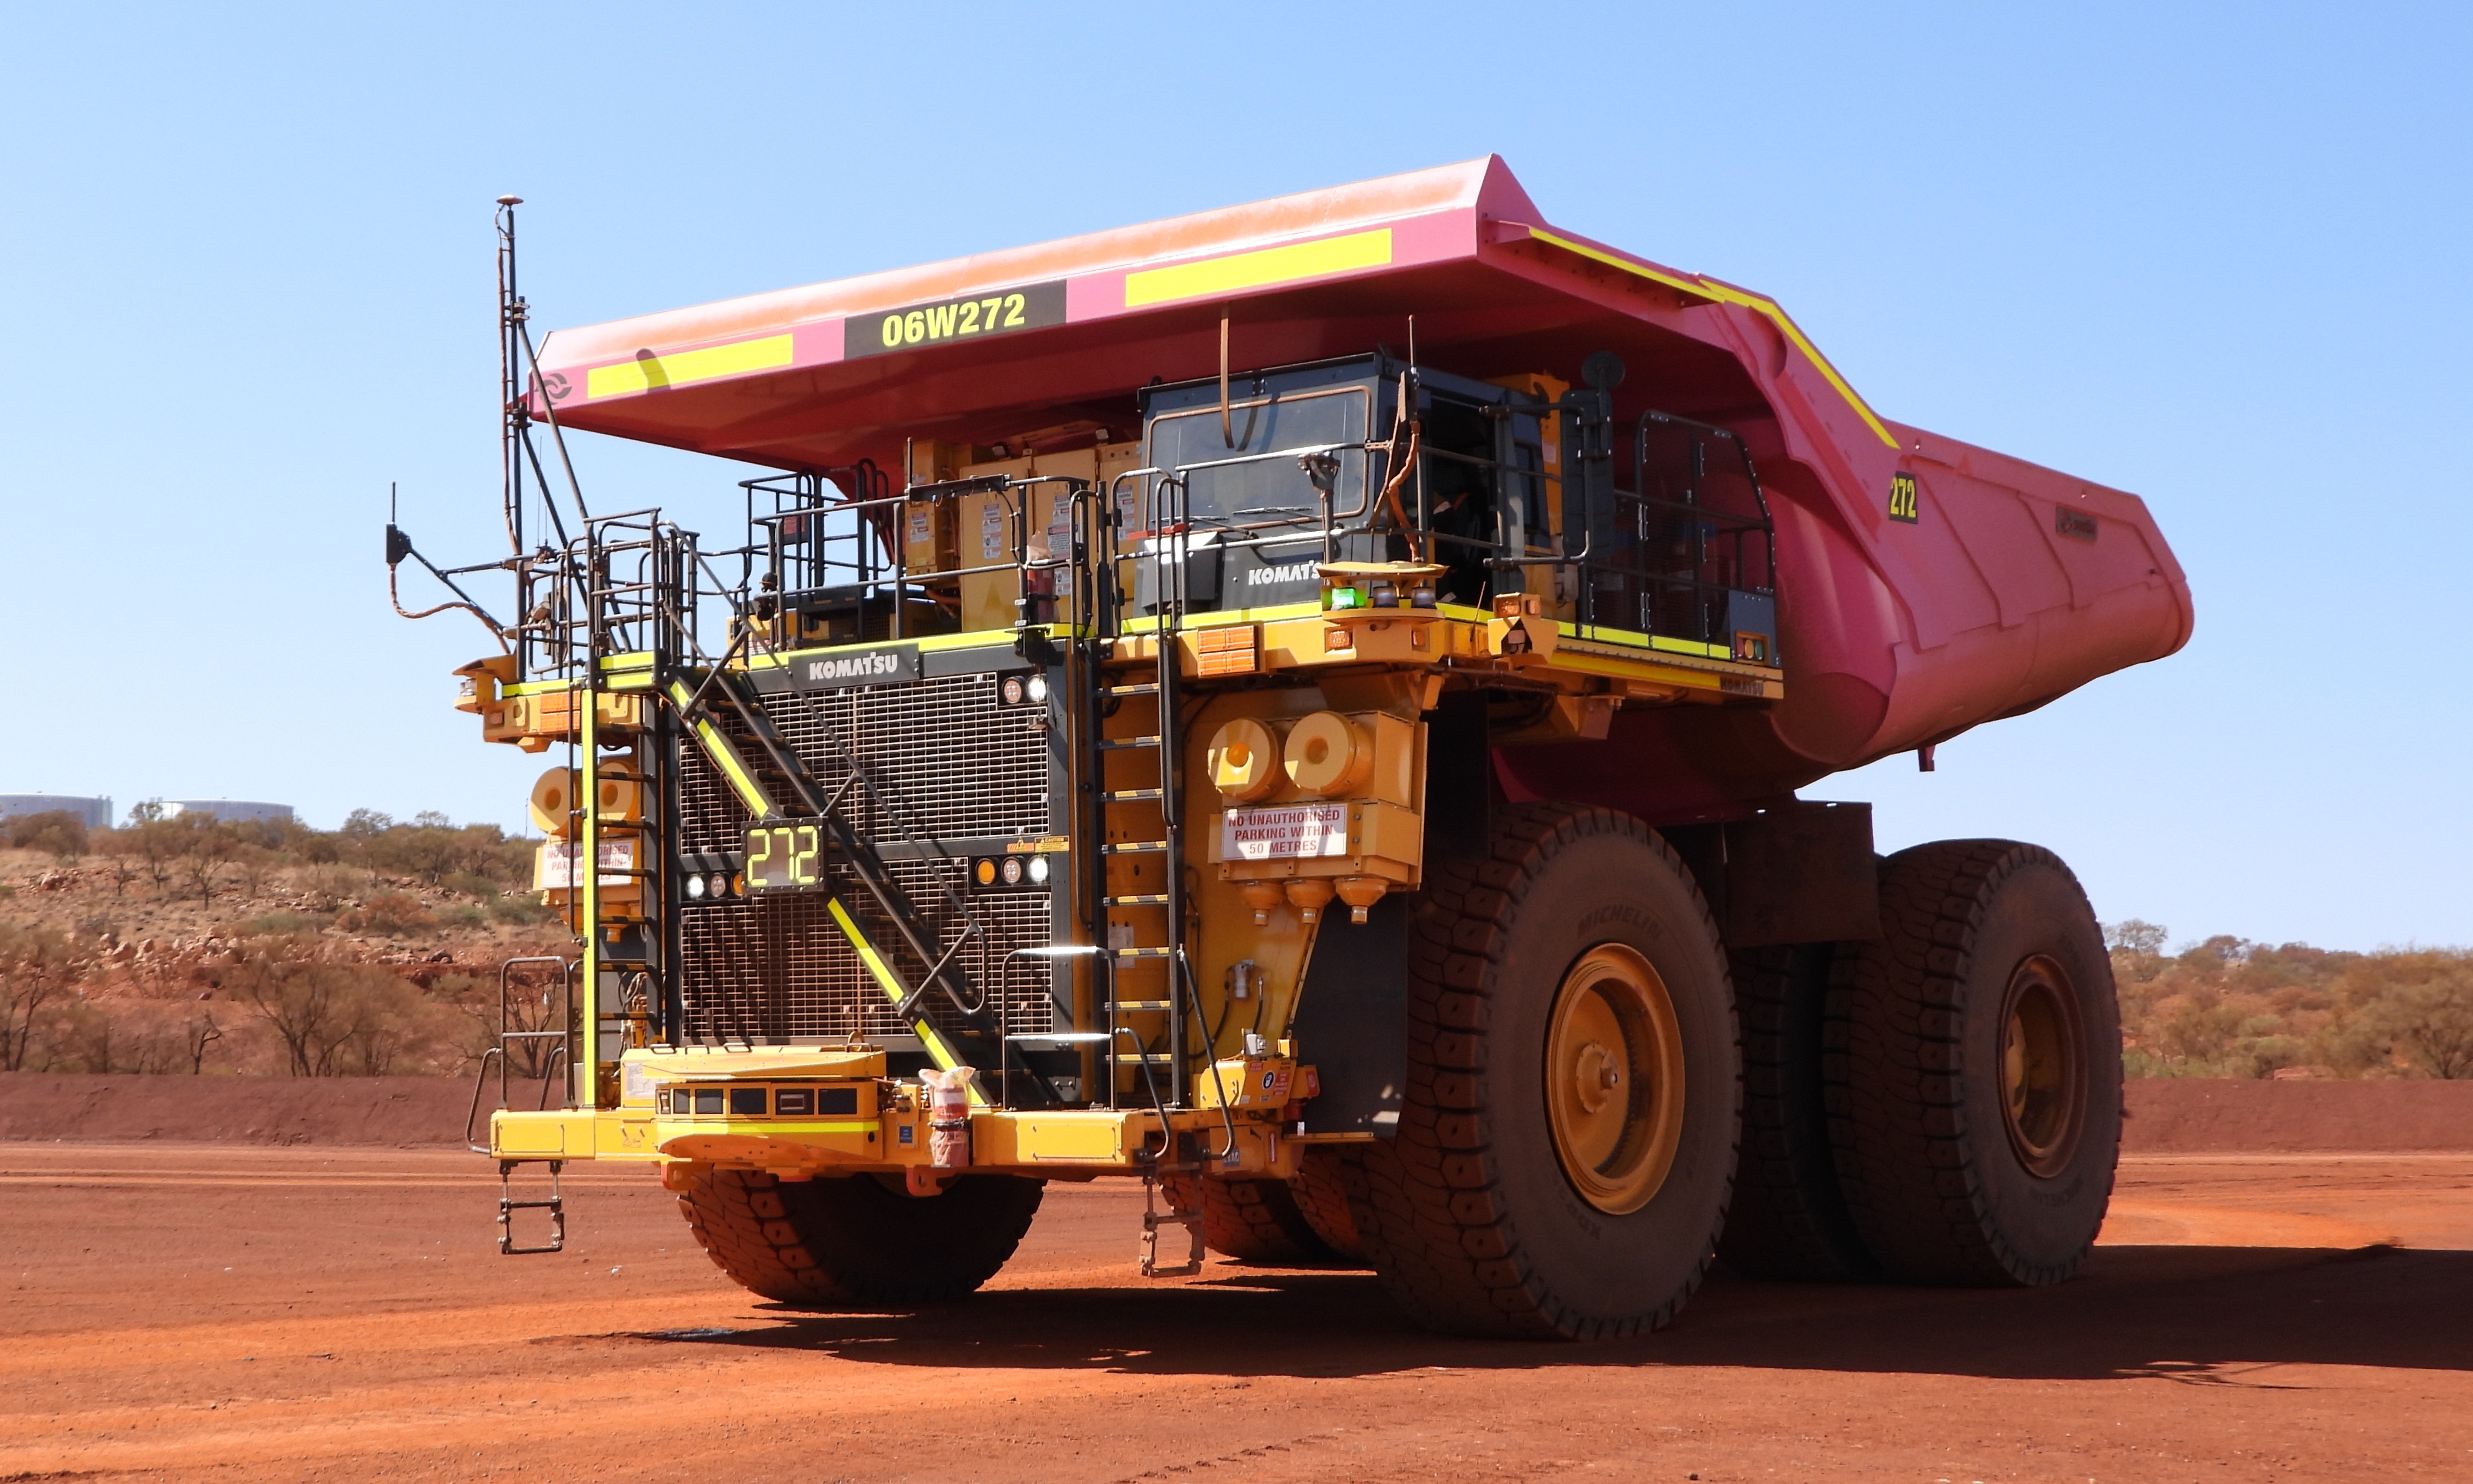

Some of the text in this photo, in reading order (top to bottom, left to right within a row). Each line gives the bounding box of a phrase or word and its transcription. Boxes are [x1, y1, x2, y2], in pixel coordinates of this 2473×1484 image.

[882, 293, 1025, 347] 06W272
[1891, 476, 1917, 518] 272
[1248, 559, 1322, 585] KOMATS
[809, 651, 898, 680] KOMATSU
[1228, 810, 1340, 827] NO UNAUTHORISED
[1235, 824, 1333, 841] PARKING WITHIN
[547, 849, 560, 859] NO
[747, 825, 818, 886] 272
[1250, 839, 1317, 854] 50 METRES
